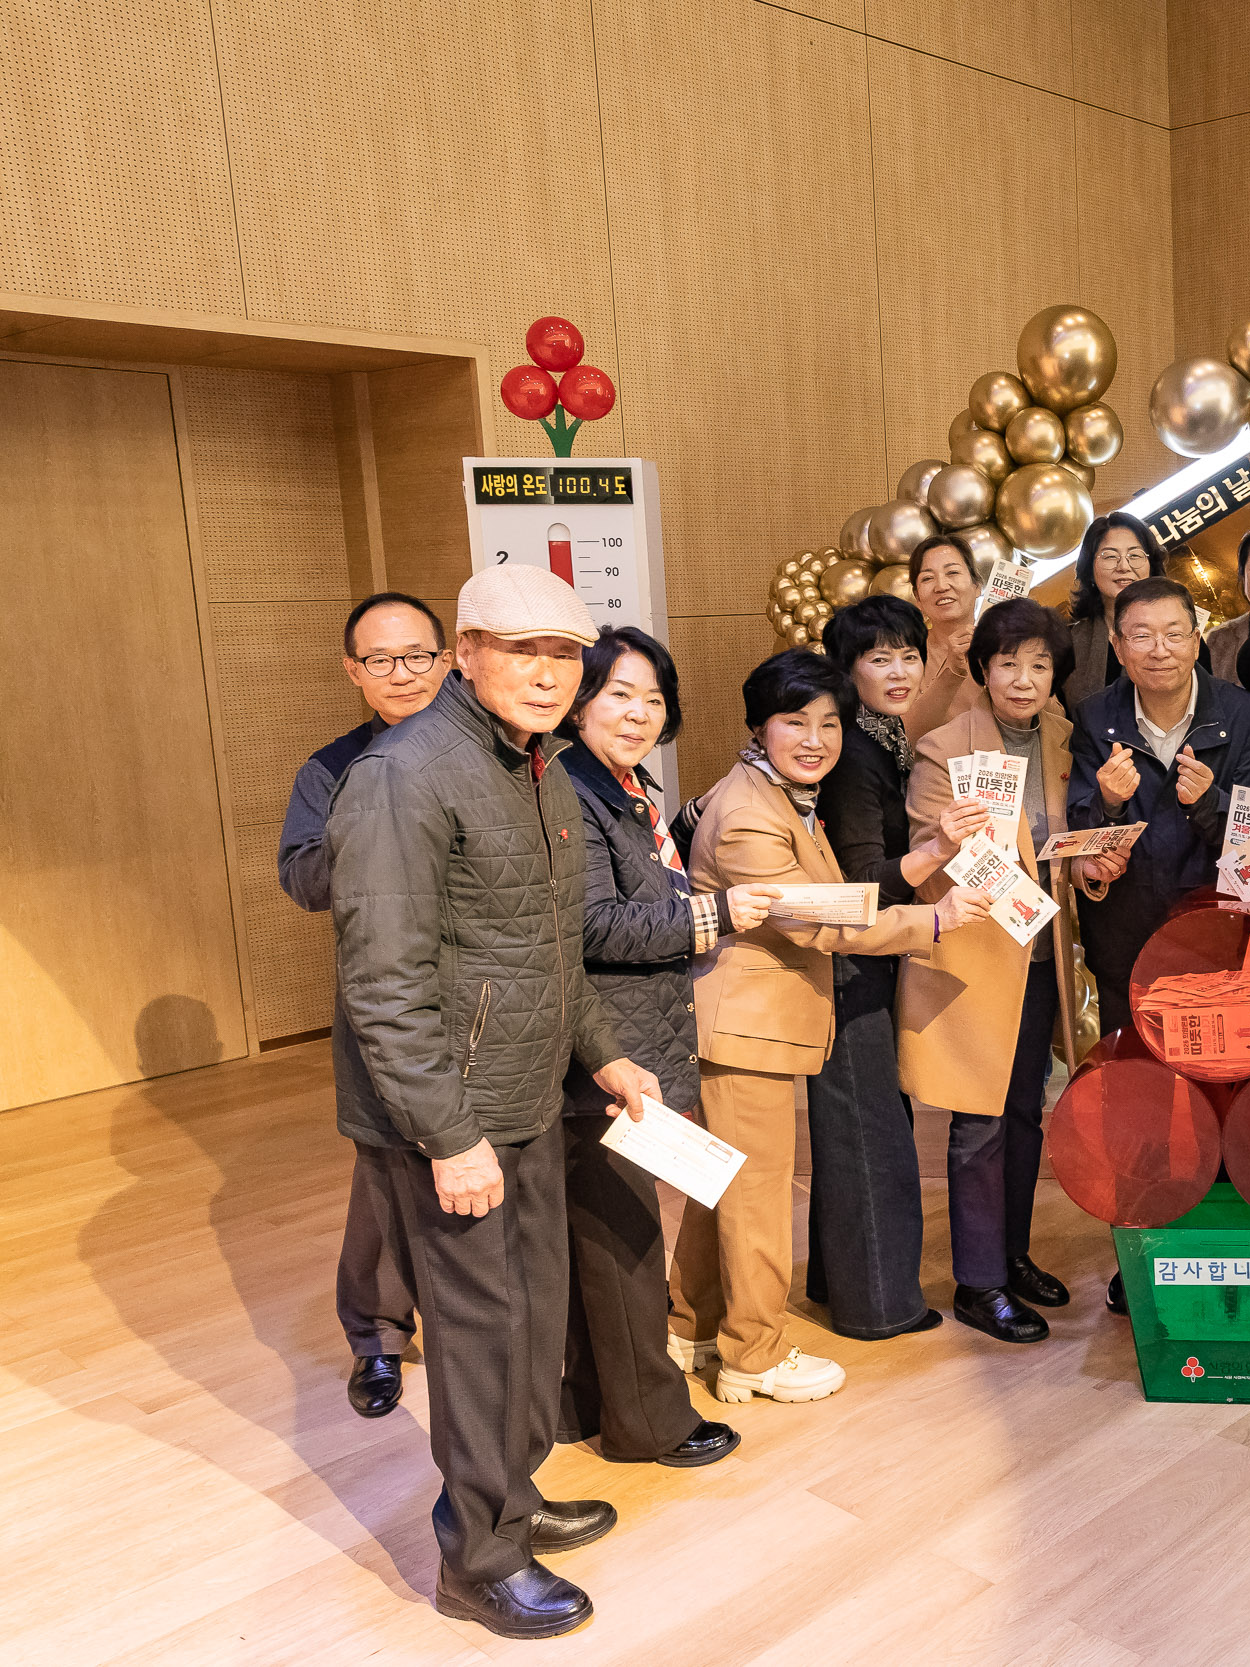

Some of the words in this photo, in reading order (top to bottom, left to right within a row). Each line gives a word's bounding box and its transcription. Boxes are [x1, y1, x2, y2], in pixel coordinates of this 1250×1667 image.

[481, 474, 519, 497] 사랑의
[523, 474, 548, 496] 온도
[614, 476, 627, 495] 도
[1149, 485, 1228, 546] 나눔의
[601, 537, 623, 548] 100
[605, 567, 620, 577] 90
[990, 586, 1017, 600] 겨울나
[992, 577, 1025, 596] 따뜻한
[607, 598, 622, 609] 80
[978, 769, 994, 777] 2026
[975, 776, 1018, 794] 따뜻한
[975, 789, 1016, 804] 겨울나기
[1235, 803, 1250, 812] 2026
[961, 867, 976, 881] 2026
[966, 854, 1003, 888] 따뜻한
[1188, 1014, 1202, 1056] 따뜻한
[1209, 1360, 1243, 1375] 사랑의
